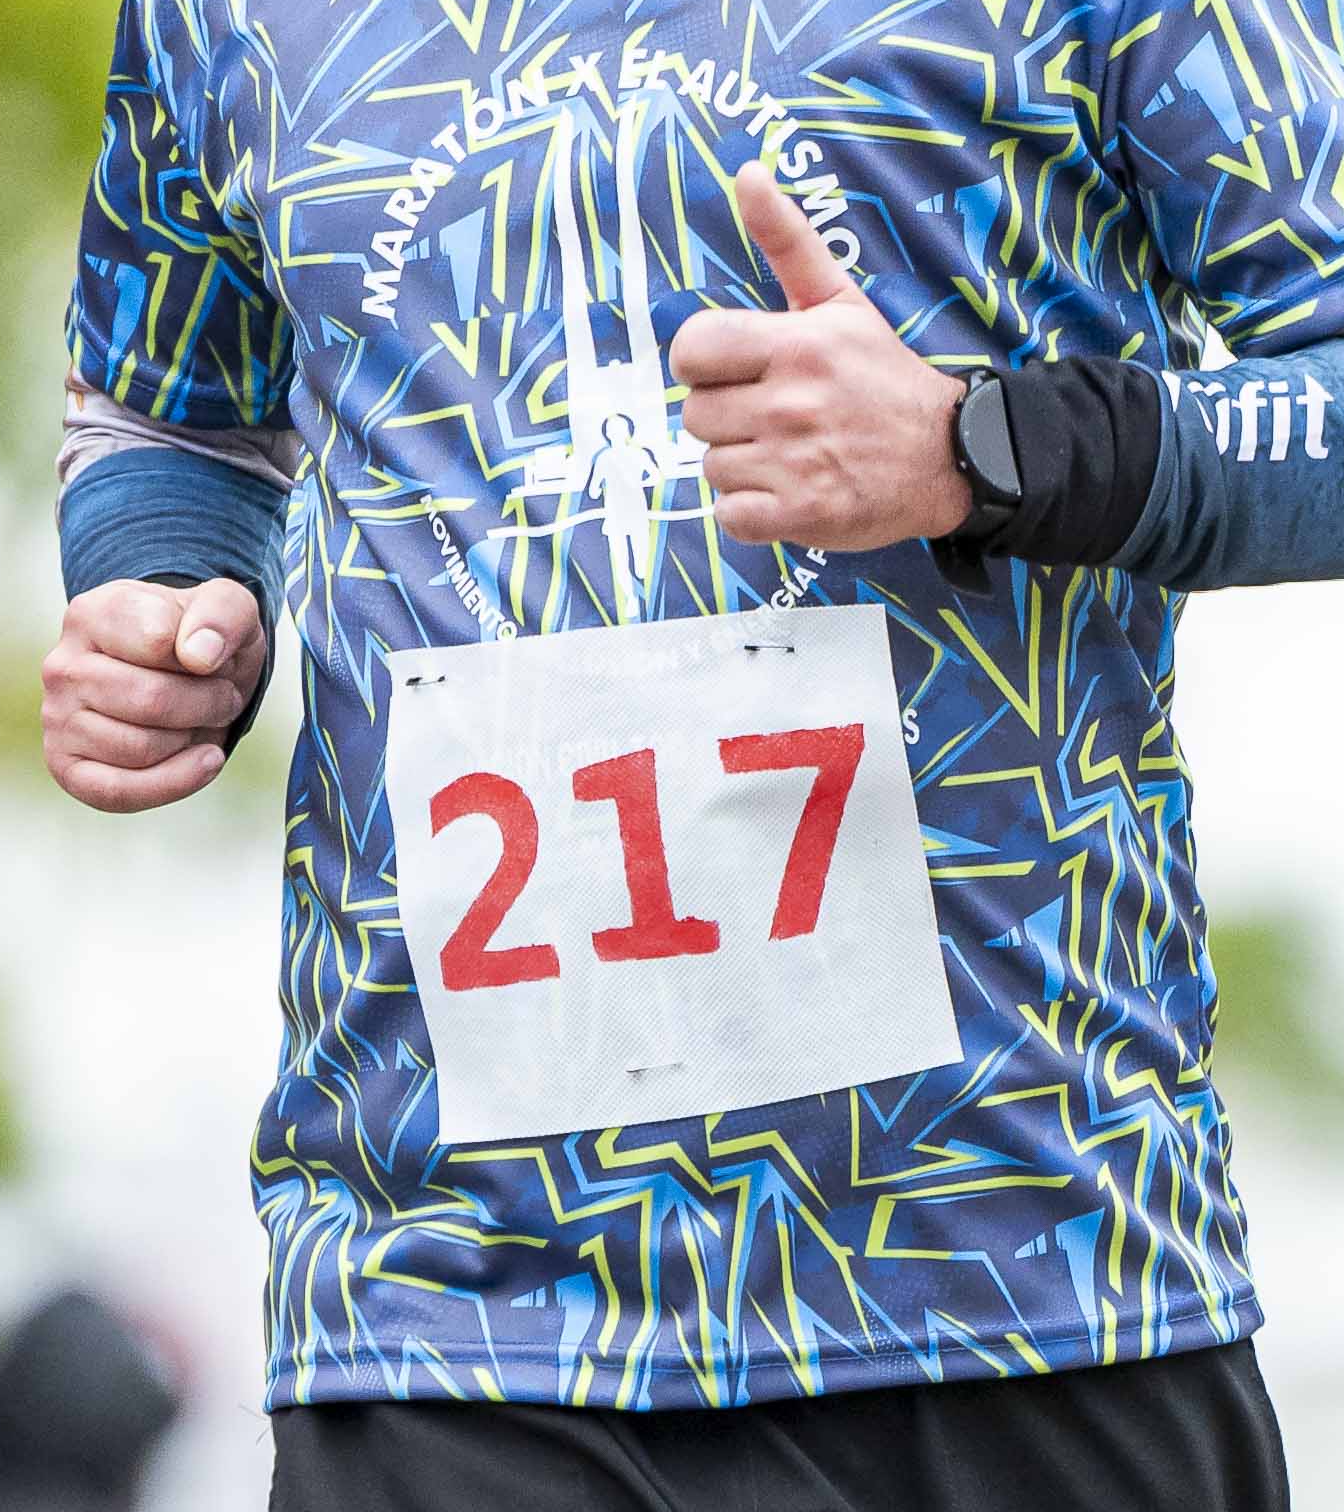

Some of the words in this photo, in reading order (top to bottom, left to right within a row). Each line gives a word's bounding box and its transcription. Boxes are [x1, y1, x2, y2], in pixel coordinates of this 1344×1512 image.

[361, 68, 549, 320] MARATÓN
[566, 51, 603, 96] X
[618, 48, 668, 89] EL
[677, 58, 861, 272] AUTISMO
[420, 494, 517, 639] MOVIMIENTO
[429, 723, 865, 991] 217
